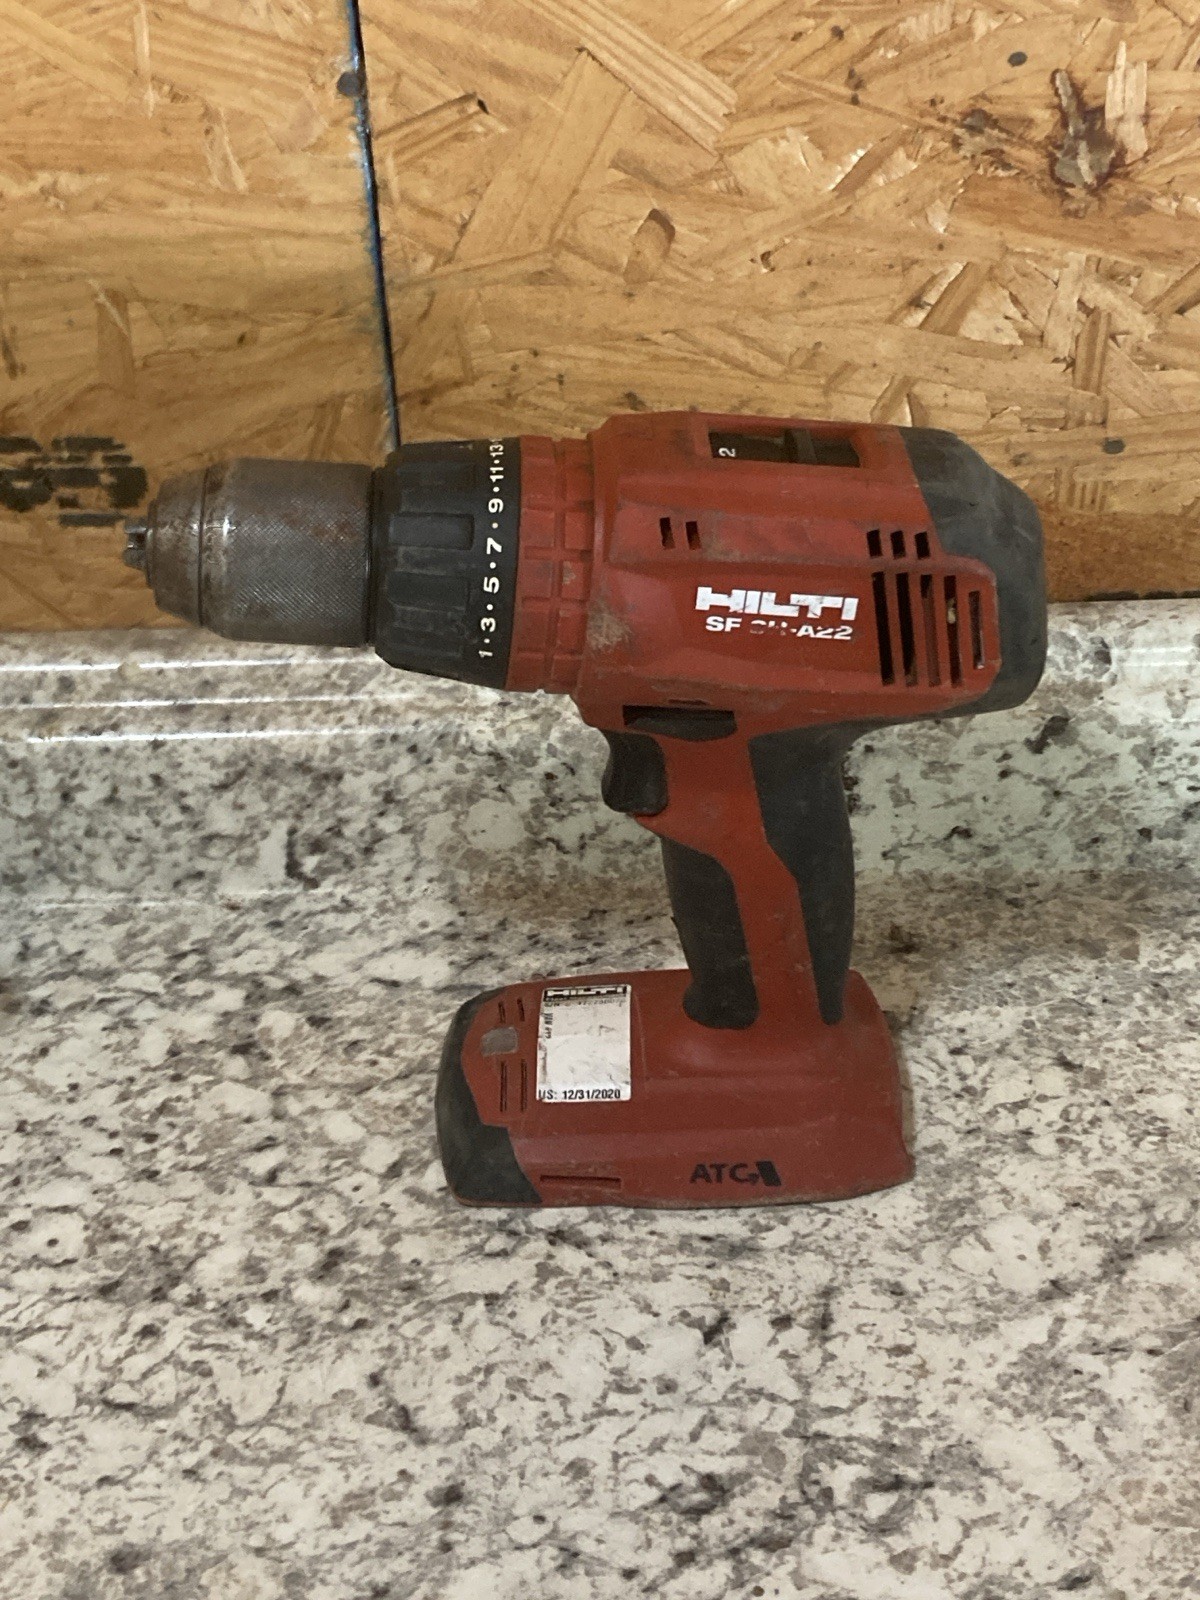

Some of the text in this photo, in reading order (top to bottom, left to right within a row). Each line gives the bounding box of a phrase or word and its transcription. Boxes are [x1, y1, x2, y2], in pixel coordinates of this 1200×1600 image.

[490, 444, 504, 458] 13
[718, 447, 736, 458] 2
[490, 466, 504, 482] 11
[488, 497, 504, 513] 9
[486, 537, 502, 554] 7
[483, 576, 500, 594] 5
[695, 586, 859, 621] HILTI
[480, 617, 496, 632] 3
[705, 615, 742, 632] SF
[538, 1088, 621, 1100] US: 12/31/2020
